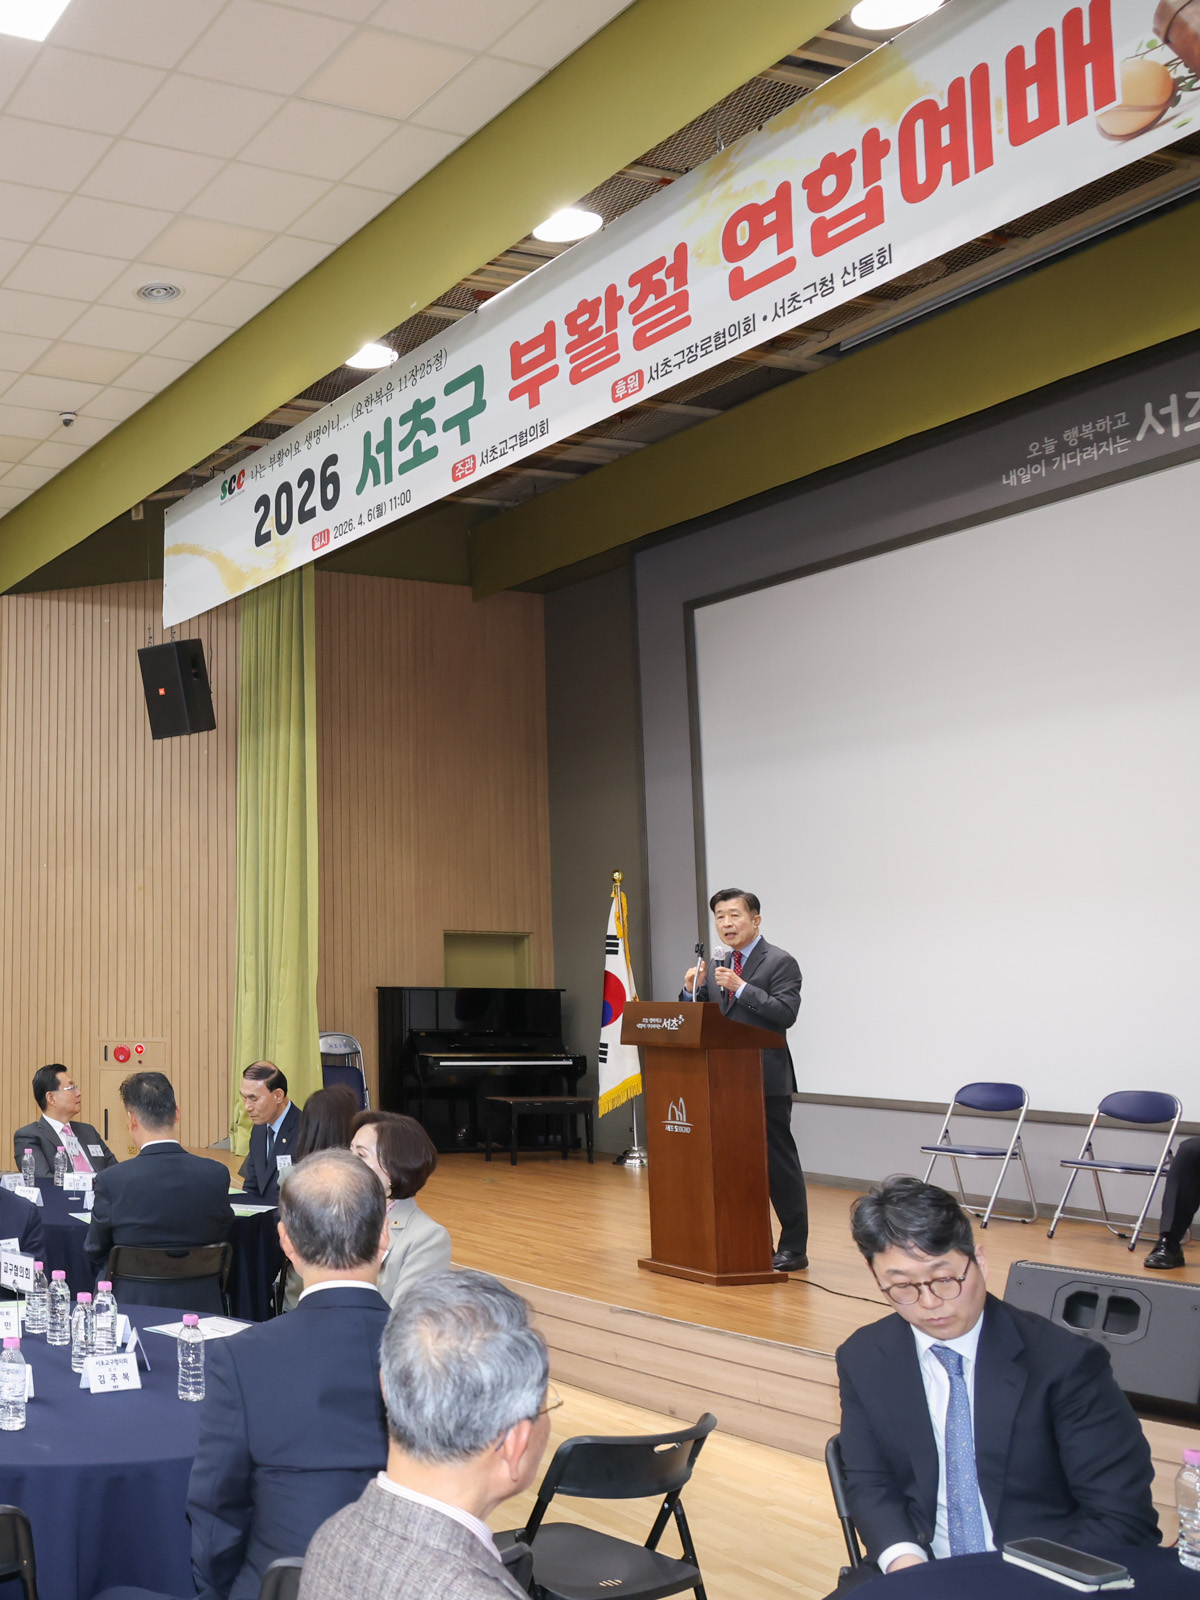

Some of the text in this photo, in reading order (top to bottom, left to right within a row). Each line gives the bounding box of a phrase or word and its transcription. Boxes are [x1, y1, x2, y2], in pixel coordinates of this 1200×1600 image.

[253, 0, 1117, 548] 2026 서초구 부활절 연합예배
[614, 242, 893, 399] 후원 서초구장로협의회 서초구청 산돌회
[250, 463, 267, 482] 나는
[268, 440, 302, 472] 부활이요
[351, 381, 395, 423] (요한복음
[398, 347, 448, 393] 11장25절)
[1026, 411, 1131, 460] 오늘 행복하고
[455, 417, 550, 479] 주관 서초교구협의회
[1002, 434, 1132, 487] 내일이 기다려지는
[333, 488, 412, 540] 2026. 4. 6(월) 11:00
[313, 531, 329, 550] 일시
[661, 1017, 679, 1030] 서초
[3, 1261, 31, 1280] 교구협의회
